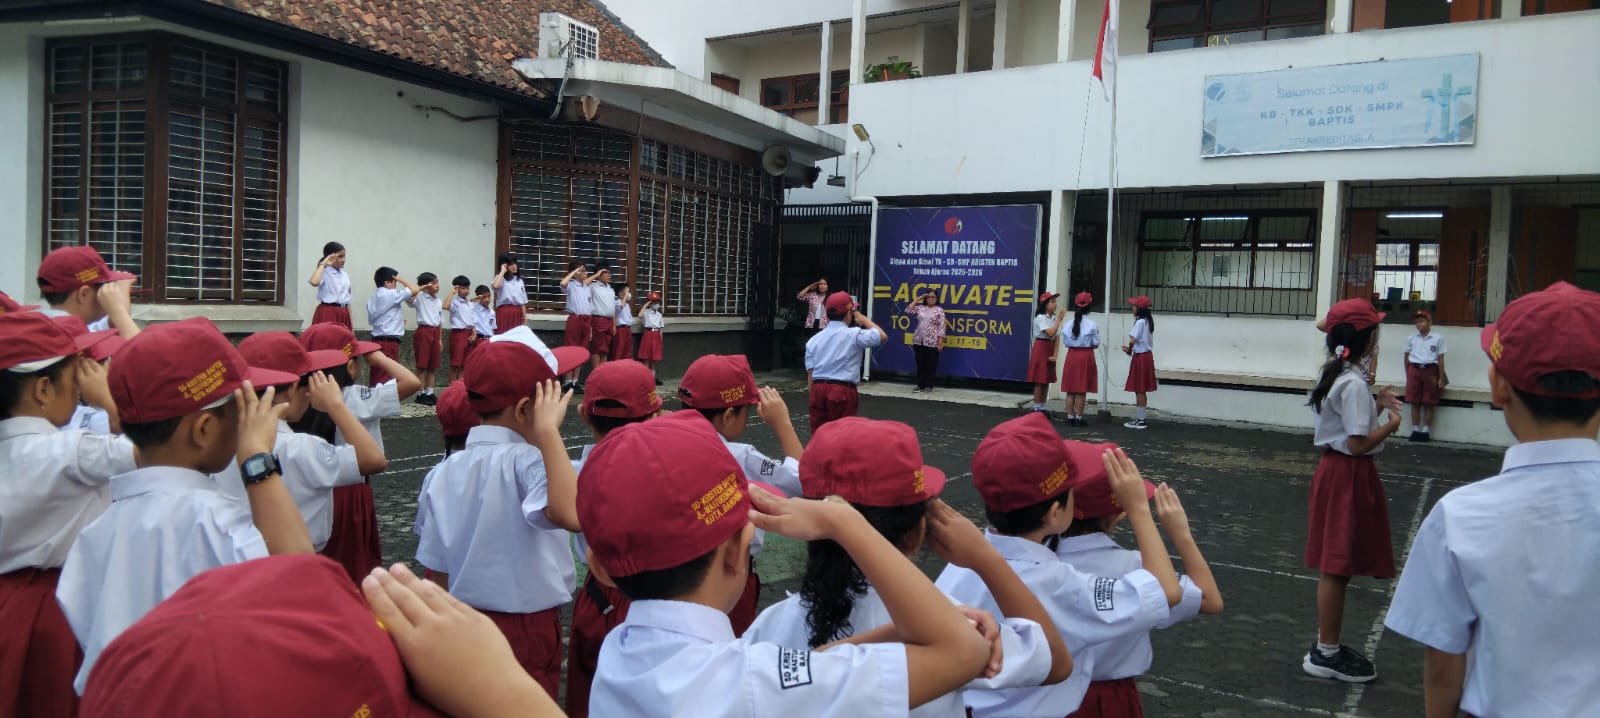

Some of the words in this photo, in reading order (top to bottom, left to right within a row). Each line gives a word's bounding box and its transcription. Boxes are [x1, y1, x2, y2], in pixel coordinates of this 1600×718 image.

[1278, 86, 1326, 99] Selamat
[1328, 82, 1375, 95] Datang
[1377, 80, 1389, 91] di
[1260, 110, 1277, 120] KB
[1289, 106, 1314, 117] TKK
[1327, 104, 1353, 115] SDK
[1367, 101, 1404, 112] SMPK
[1308, 115, 1356, 127] BAPTIS
[901, 240, 949, 255] SELAMAT
[952, 240, 996, 255] DATANG
[996, 258, 1018, 267] BAPTIS
[893, 282, 1014, 306] ACTIVATE
[891, 315, 911, 330] TO
[945, 318, 1013, 336] NSFORM
[701, 484, 724, 505] KRISTEN
[705, 509, 721, 526] KOTA
[783, 671, 792, 682] SD
